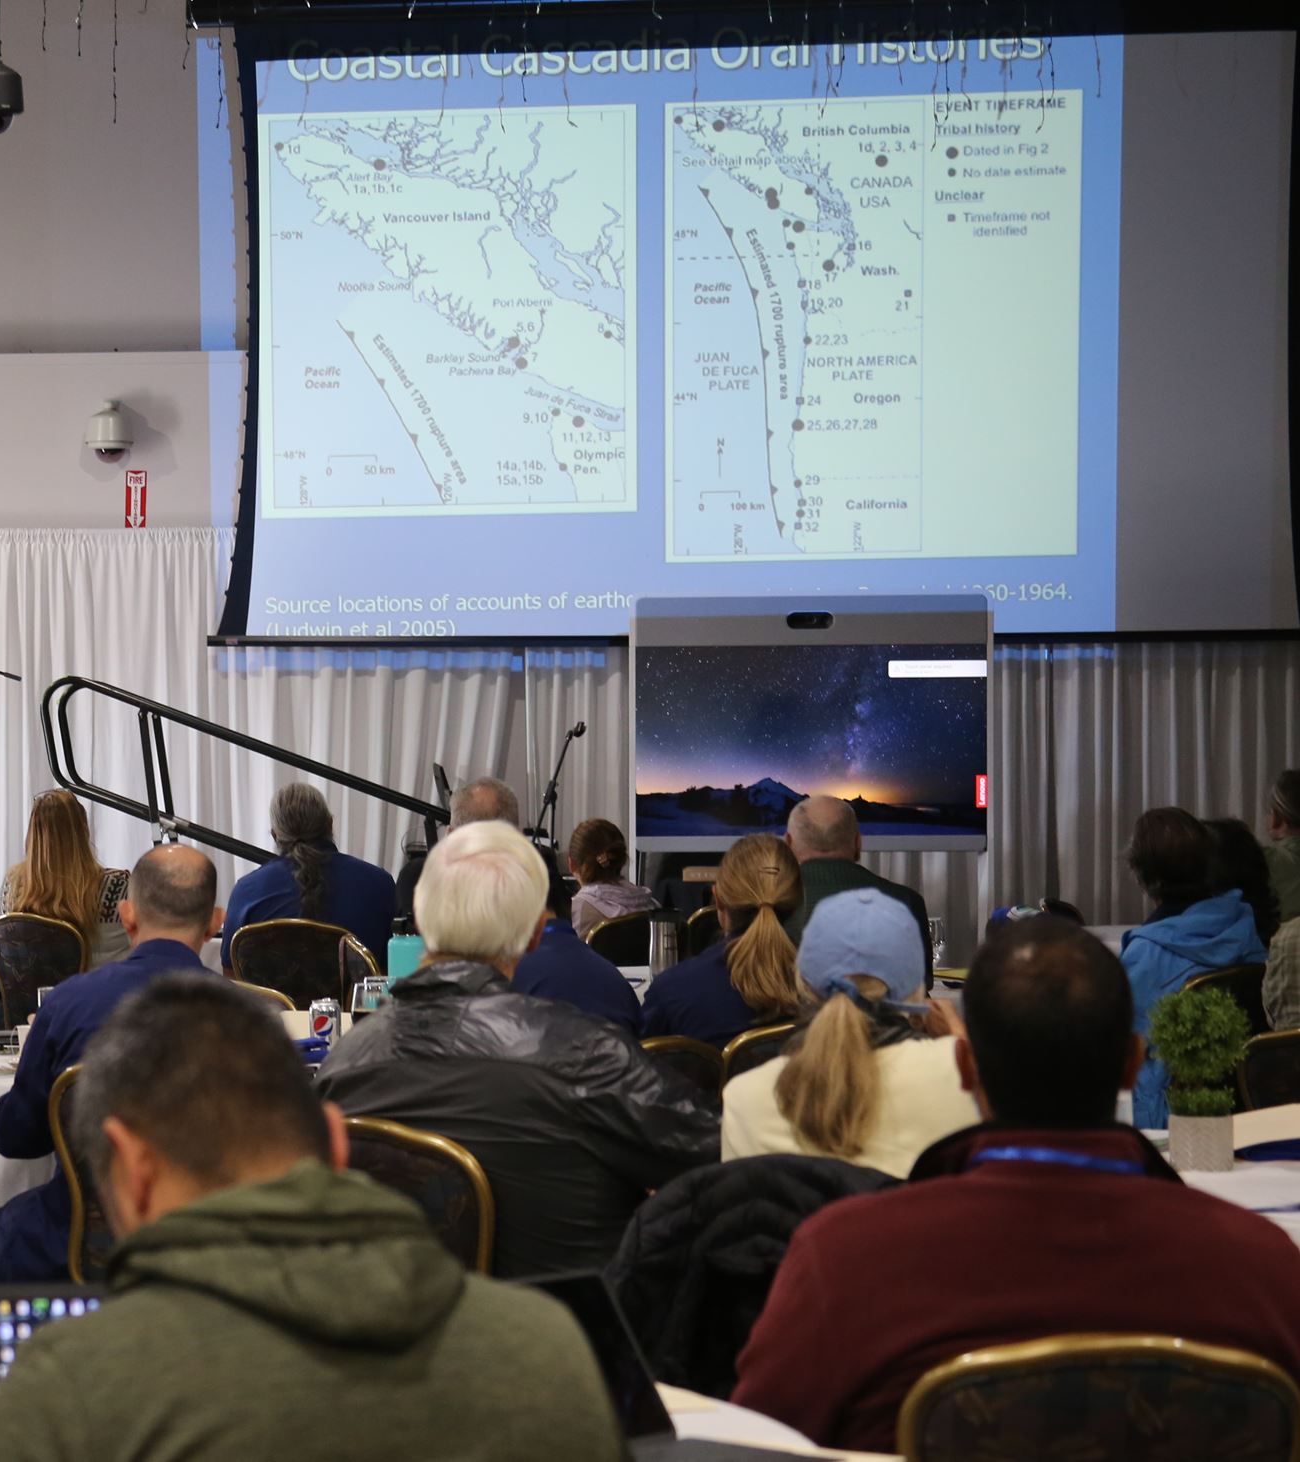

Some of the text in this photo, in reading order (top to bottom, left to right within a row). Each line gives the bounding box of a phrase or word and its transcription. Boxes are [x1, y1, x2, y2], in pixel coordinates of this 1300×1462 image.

[288, 22, 1045, 81] Coastal Cascadia Oral Histories
[936, 98, 1066, 112] EVENT TIMEFRAME
[802, 125, 910, 138] British Columbia
[935, 123, 1021, 136] Tribal history
[288, 144, 300, 154] 1d
[909, 141, 917, 151] 4
[963, 143, 1049, 157] Dated in Fig 2
[682, 156, 705, 167] See
[709, 155, 741, 166] detail
[745, 157, 771, 168] map
[962, 166, 1067, 178] No date estimate
[346, 173, 393, 183] Alert Bay
[850, 177, 913, 189] CANADA
[935, 190, 985, 202] Unclear
[860, 196, 891, 208] USA
[383, 211, 490, 224] Vancouver Island
[963, 211, 1050, 223] Timeframe not
[973, 226, 1028, 237] identified
[858, 241, 872, 251] 16
[861, 265, 900, 276] Wash.
[824, 273, 837, 283] 17
[338, 281, 411, 293] Nootka Sound
[694, 282, 732, 293] Pacific
[808, 280, 821, 290] 18
[493, 299, 514, 308] Port
[694, 295, 730, 305] Ocean
[895, 302, 909, 311] 21
[746, 228, 788, 400] Estimated 1700 rupture area
[426, 352, 500, 364] Barkley Sound
[531, 353, 538, 362] 7
[694, 352, 730, 363] JUAN
[807, 355, 917, 368] NORTH AMERICA
[304, 366, 340, 376] Pacific
[449, 367, 517, 377] Pachena Bay
[702, 366, 759, 376] DE FUCA
[832, 370, 873, 381] PLATE
[304, 379, 340, 389] Ocean
[709, 379, 750, 390] PLATE
[524, 386, 549, 400] Juan
[565, 398, 591, 414] Fuca
[593, 407, 621, 423] Strait
[807, 396, 821, 406] 24
[853, 392, 901, 406] Oregon
[372, 334, 467, 485] Estimated 1700 rupture area
[573, 448, 625, 462] Olympic
[364, 465, 395, 475] 50 km
[573, 464, 601, 474] Pen.
[130, 476, 143, 485] FIRE
[804, 476, 820, 486] 29
[730, 502, 765, 511] 100 km
[808, 497, 823, 506] 30
[845, 499, 908, 510] California
[806, 509, 820, 518] 31
[804, 522, 819, 532] 32
[265, 597, 331, 614] Source
[338, 595, 423, 613] locations
[429, 594, 449, 611] of
[455, 594, 542, 611] accounts
[548, 592, 569, 609] of
[350, 623, 369, 636] et
[375, 621, 392, 636] al
[400, 619, 456, 636] 2005)
[978, 778, 986, 805] Lenovo
